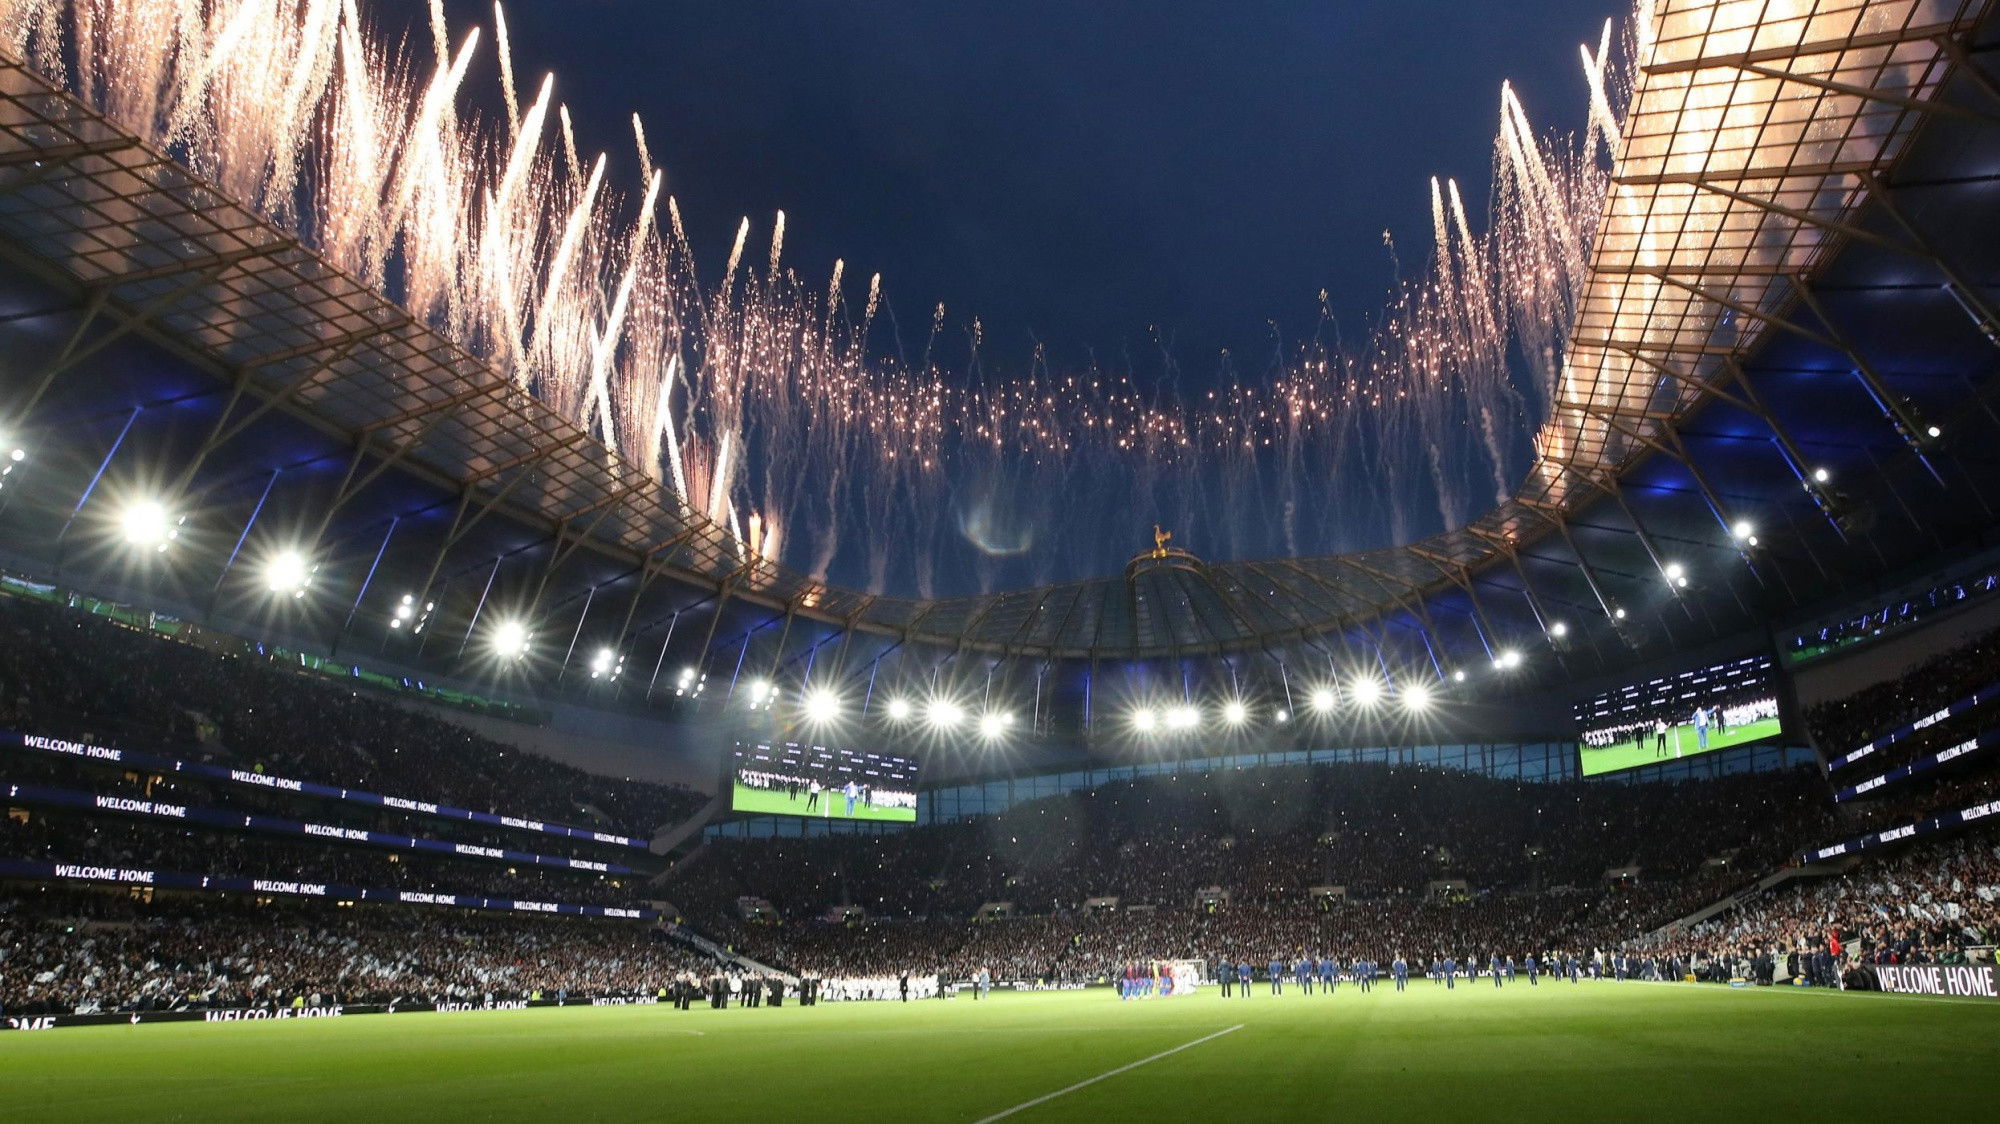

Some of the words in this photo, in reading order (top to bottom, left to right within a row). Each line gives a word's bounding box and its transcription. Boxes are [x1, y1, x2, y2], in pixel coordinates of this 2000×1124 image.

[24, 734, 85, 755] WELCOME
[86, 745, 122, 761] HOME
[1936, 745, 1962, 763] WELCOME
[1961, 738, 1979, 754] HOME
[231, 769, 275, 787] WELCOME
[276, 777, 302, 791] HOME
[96, 795, 152, 813] WELCOME
[153, 803, 186, 817] HOME
[383, 796, 416, 810] WELCOME
[417, 801, 438, 814] HOME
[1960, 803, 1991, 821] WELCOME
[304, 823, 344, 838] WELCOME
[345, 829, 369, 841] HOME
[501, 816, 527, 829] WELCOME
[528, 821, 544, 831] HOME
[455, 843, 485, 856] WELCOME
[485, 848, 504, 858] HOME
[55, 864, 116, 881] WELCOME
[119, 869, 154, 883] HOME
[253, 879, 298, 894] WELCOME
[299, 883, 326, 896] HOME
[400, 891, 434, 903] WELCOME
[435, 895, 456, 905] HOME
[513, 901, 541, 912] WELCOME
[541, 903, 558, 913] HOME
[1876, 966, 1945, 995] WELCOME
[1945, 966, 1998, 997] HOME
[297, 1006, 343, 1019] HOME
[436, 1001, 494, 1012] WELCE
[496, 1000, 528, 1010] HOME
